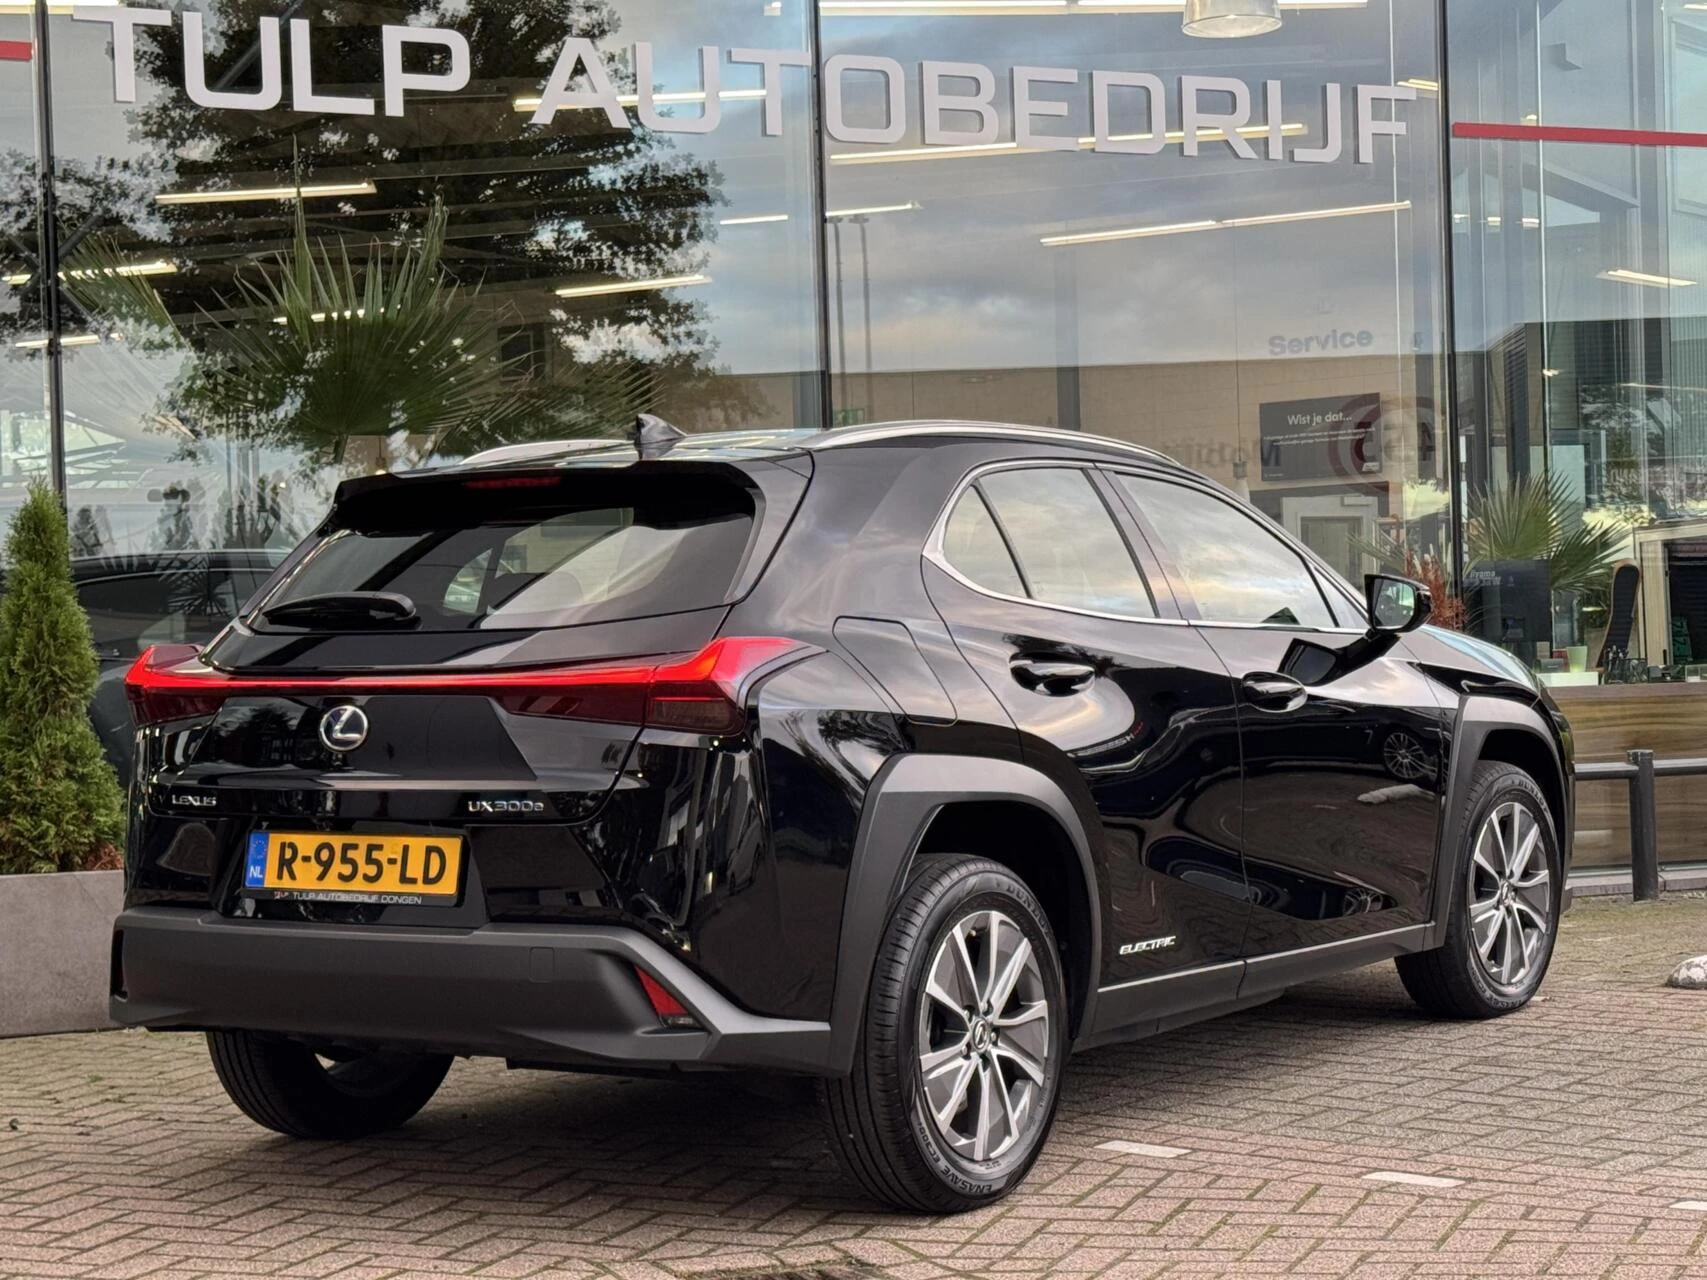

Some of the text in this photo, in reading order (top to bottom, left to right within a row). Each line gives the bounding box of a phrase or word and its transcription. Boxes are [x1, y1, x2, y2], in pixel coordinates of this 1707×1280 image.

[72, 6, 1418, 165] TULP AUTOBEDRIJF
[1268, 329, 1374, 356] Service
[1287, 413, 1311, 425] Wist
[1311, 412, 1322, 426] je
[172, 794, 217, 807] LEXUS
[468, 800, 544, 812] UX300e
[249, 865, 263, 879] NL
[276, 841, 447, 886] R-955-LD
[293, 891, 318, 901] TULP
[317, 893, 380, 904] AUTOBEDRIJF
[381, 895, 423, 905] DONGEN
[1119, 935, 1177, 955] ELECTRIC
[940, 1165, 993, 1193] ENASAVE
